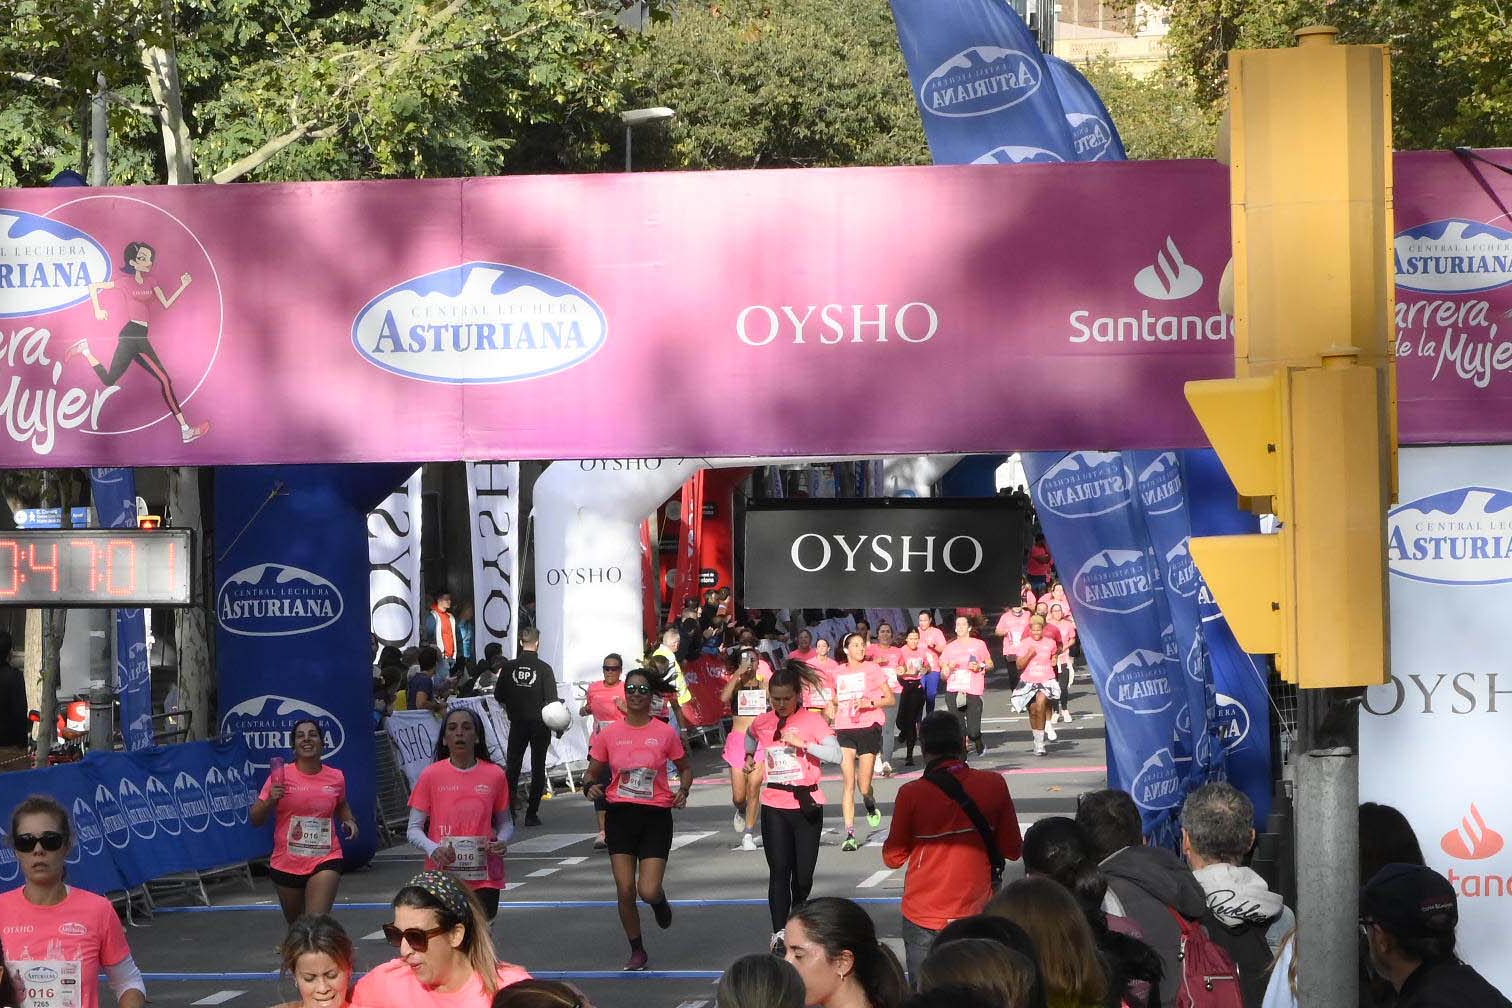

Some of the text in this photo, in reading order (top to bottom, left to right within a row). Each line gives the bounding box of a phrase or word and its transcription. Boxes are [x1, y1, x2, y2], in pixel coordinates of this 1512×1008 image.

[14, 245, 87, 257] LECHERA
[1408, 242, 1512, 253] CENTRAL LECHER
[411, 302, 579, 318] CENTRAL LECHERA
[1395, 300, 1490, 328] arrera
[372, 309, 589, 354] ASTURIANA
[735, 302, 940, 347] OYSHO
[1069, 310, 1234, 343] Santand
[1418, 330, 1436, 357] la
[1432, 324, 1512, 388] Muje
[580, 458, 662, 471] OYSHO
[1416, 521, 1482, 532] CENTRAL
[791, 533, 983, 575] OYSHO
[1388, 524, 1512, 561] ASTURIA
[547, 566, 622, 587] OYSHO
[234, 587, 329, 597] CENTRAL LECHERA
[221, 592, 334, 620] ASTURIANA
[1362, 671, 1512, 717] OYSH
[236, 720, 277, 728] CENTRAL
[28, 988, 55, 998] 016
